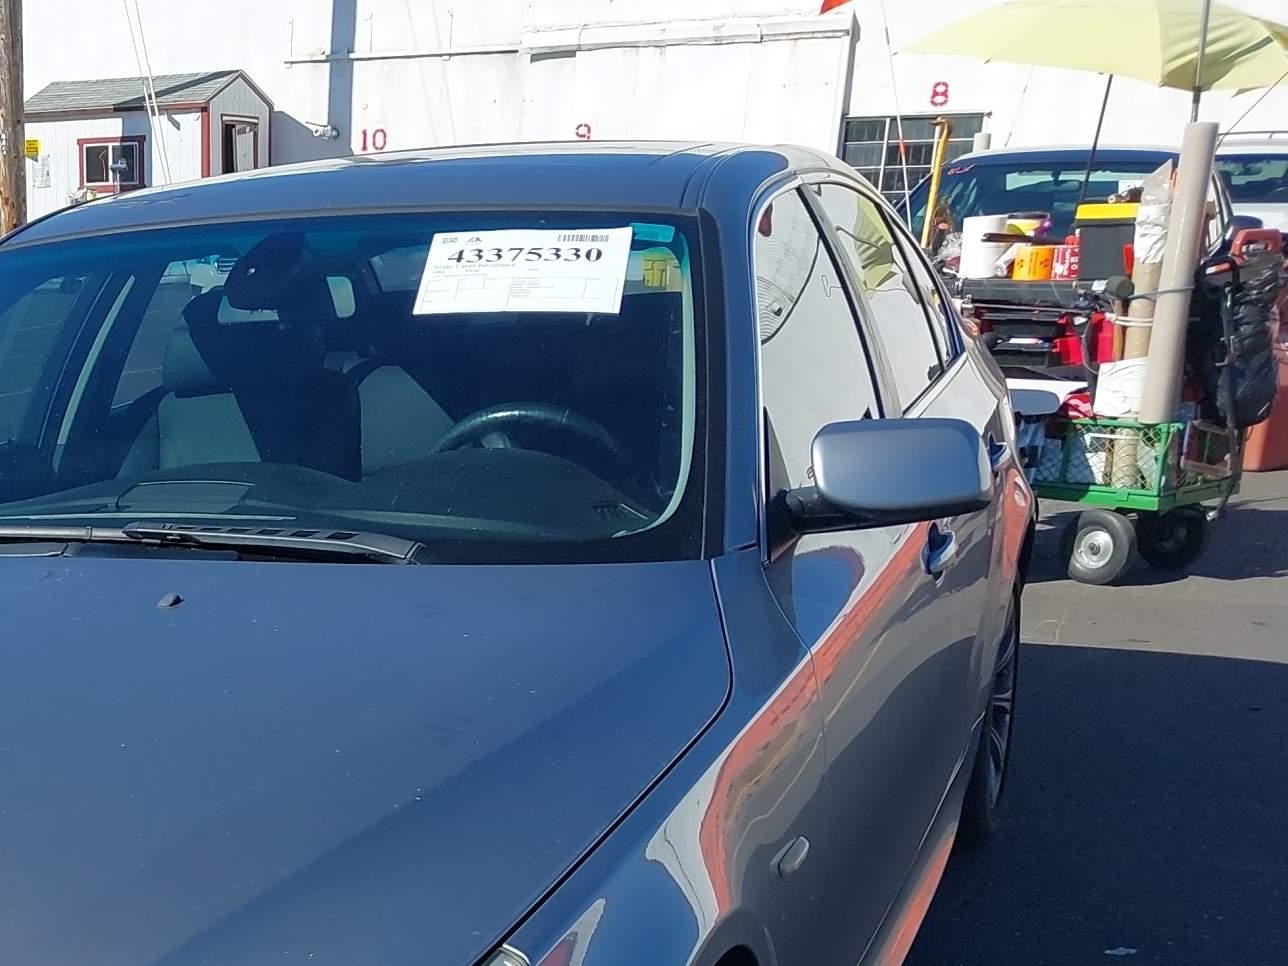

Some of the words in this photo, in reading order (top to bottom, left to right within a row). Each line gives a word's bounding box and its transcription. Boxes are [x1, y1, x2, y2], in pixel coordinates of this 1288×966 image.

[931, 81, 949, 107] 8
[362, 128, 387, 151] 10
[575, 123, 591, 141] 9
[447, 247, 603, 263] 43375330
